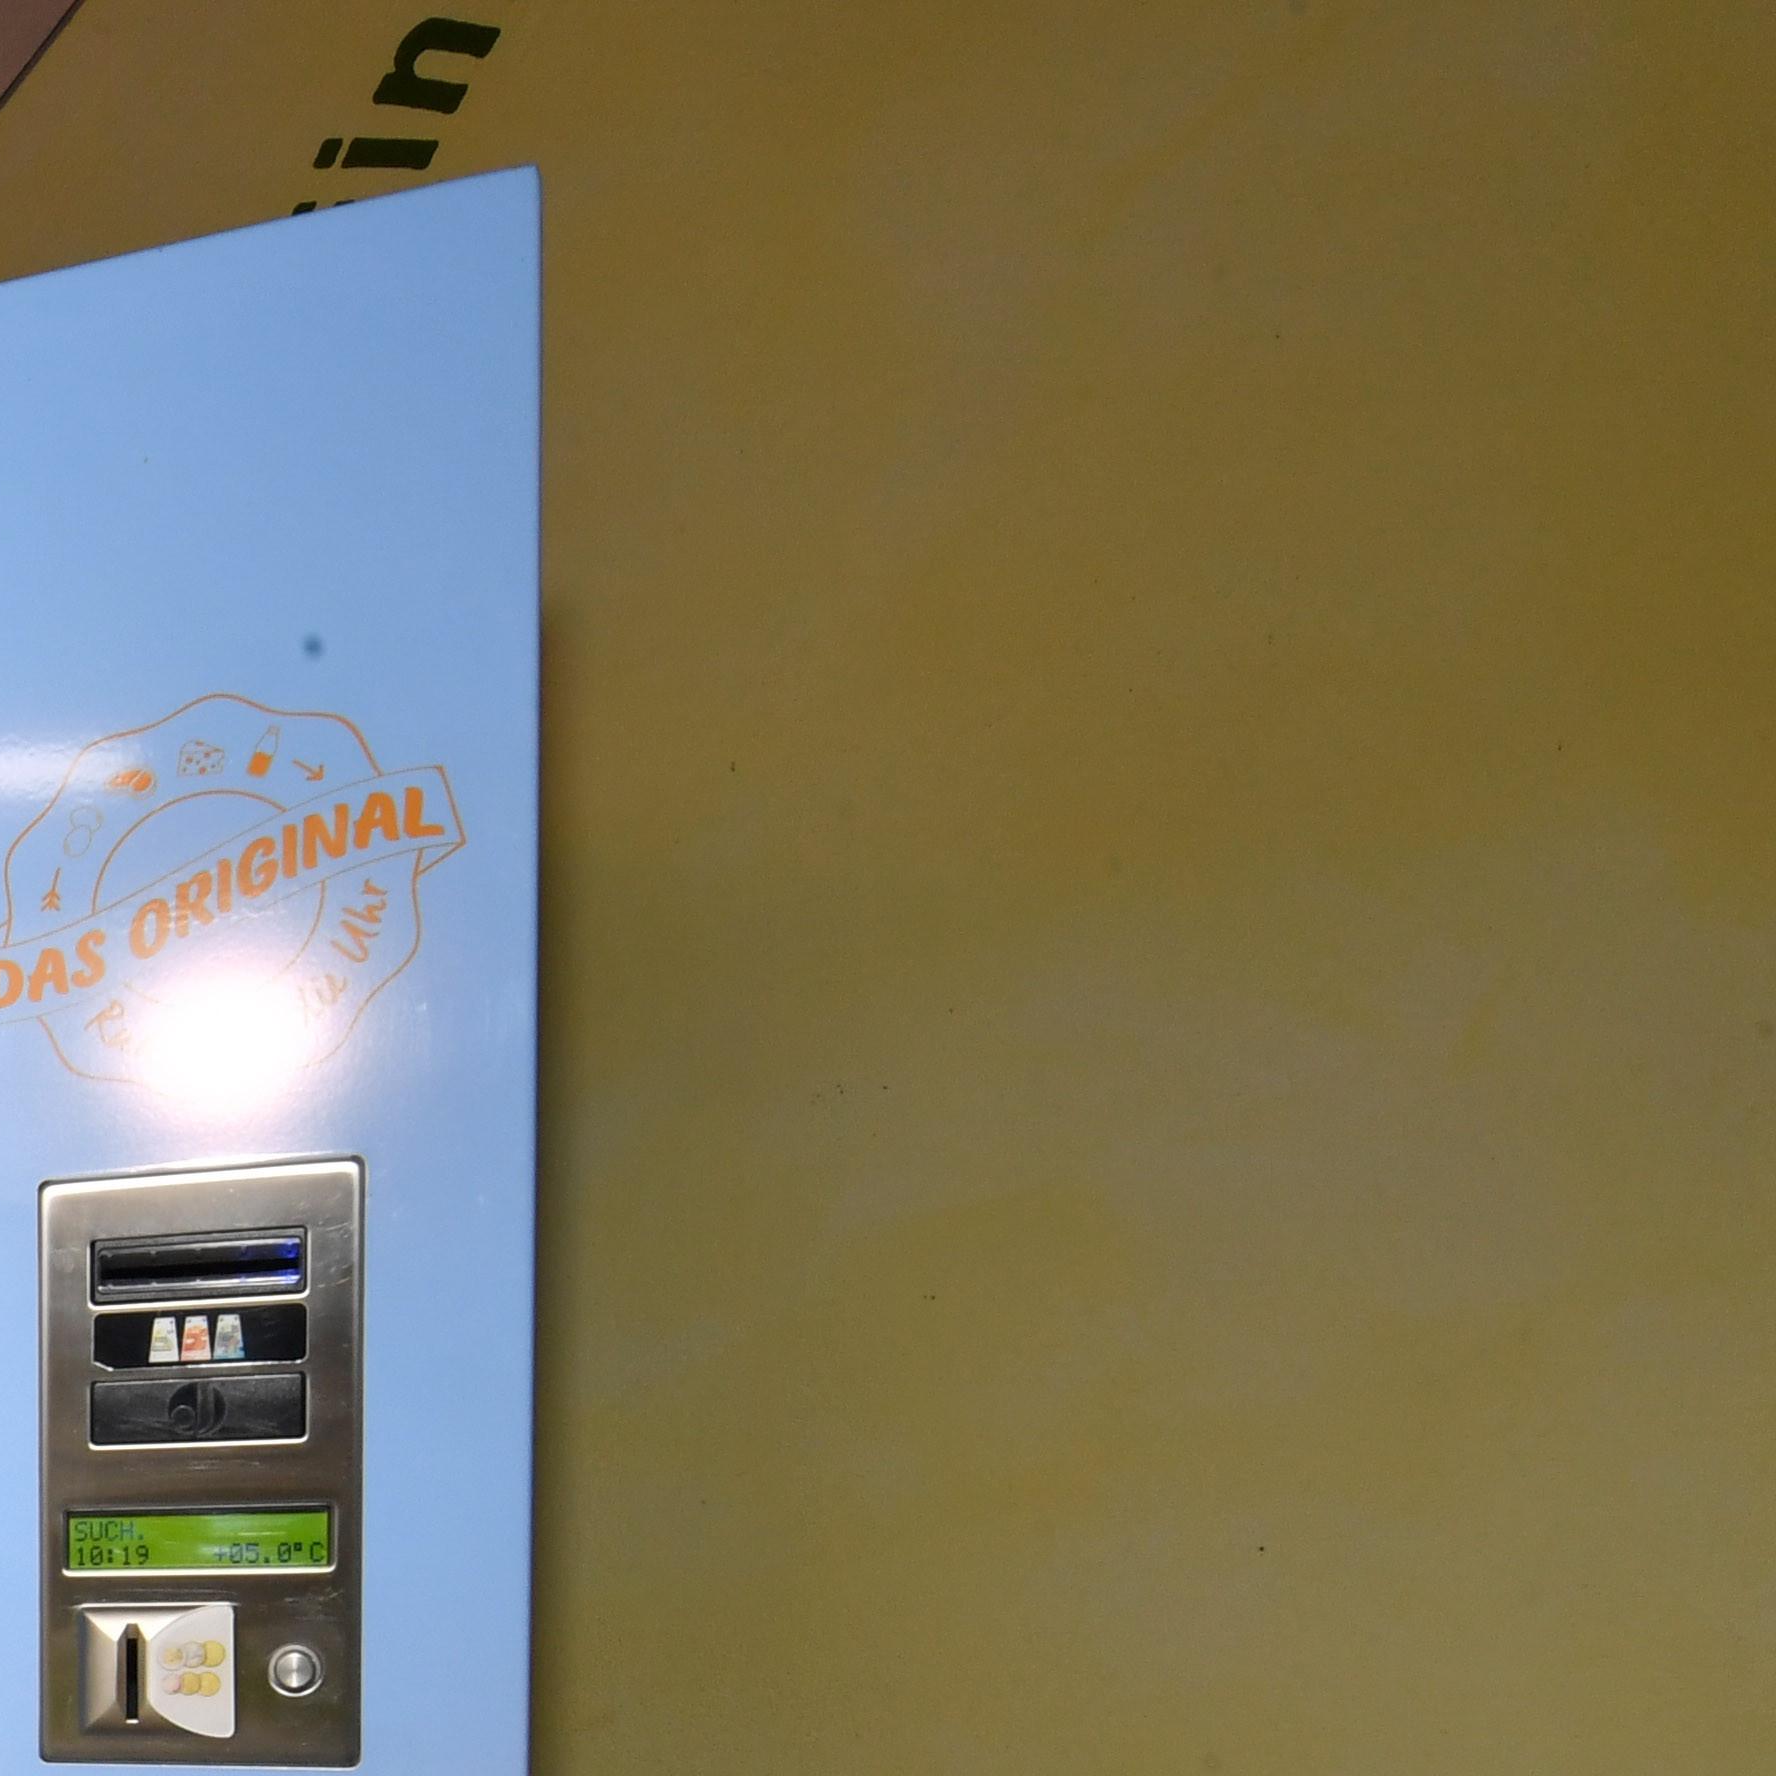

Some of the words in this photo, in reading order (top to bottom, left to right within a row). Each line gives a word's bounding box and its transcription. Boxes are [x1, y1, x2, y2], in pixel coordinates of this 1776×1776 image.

[128, 785, 446, 960] ORIGINAL
[331, 877, 390, 966] Uhr
[76, 1544, 149, 1566] 10:19
